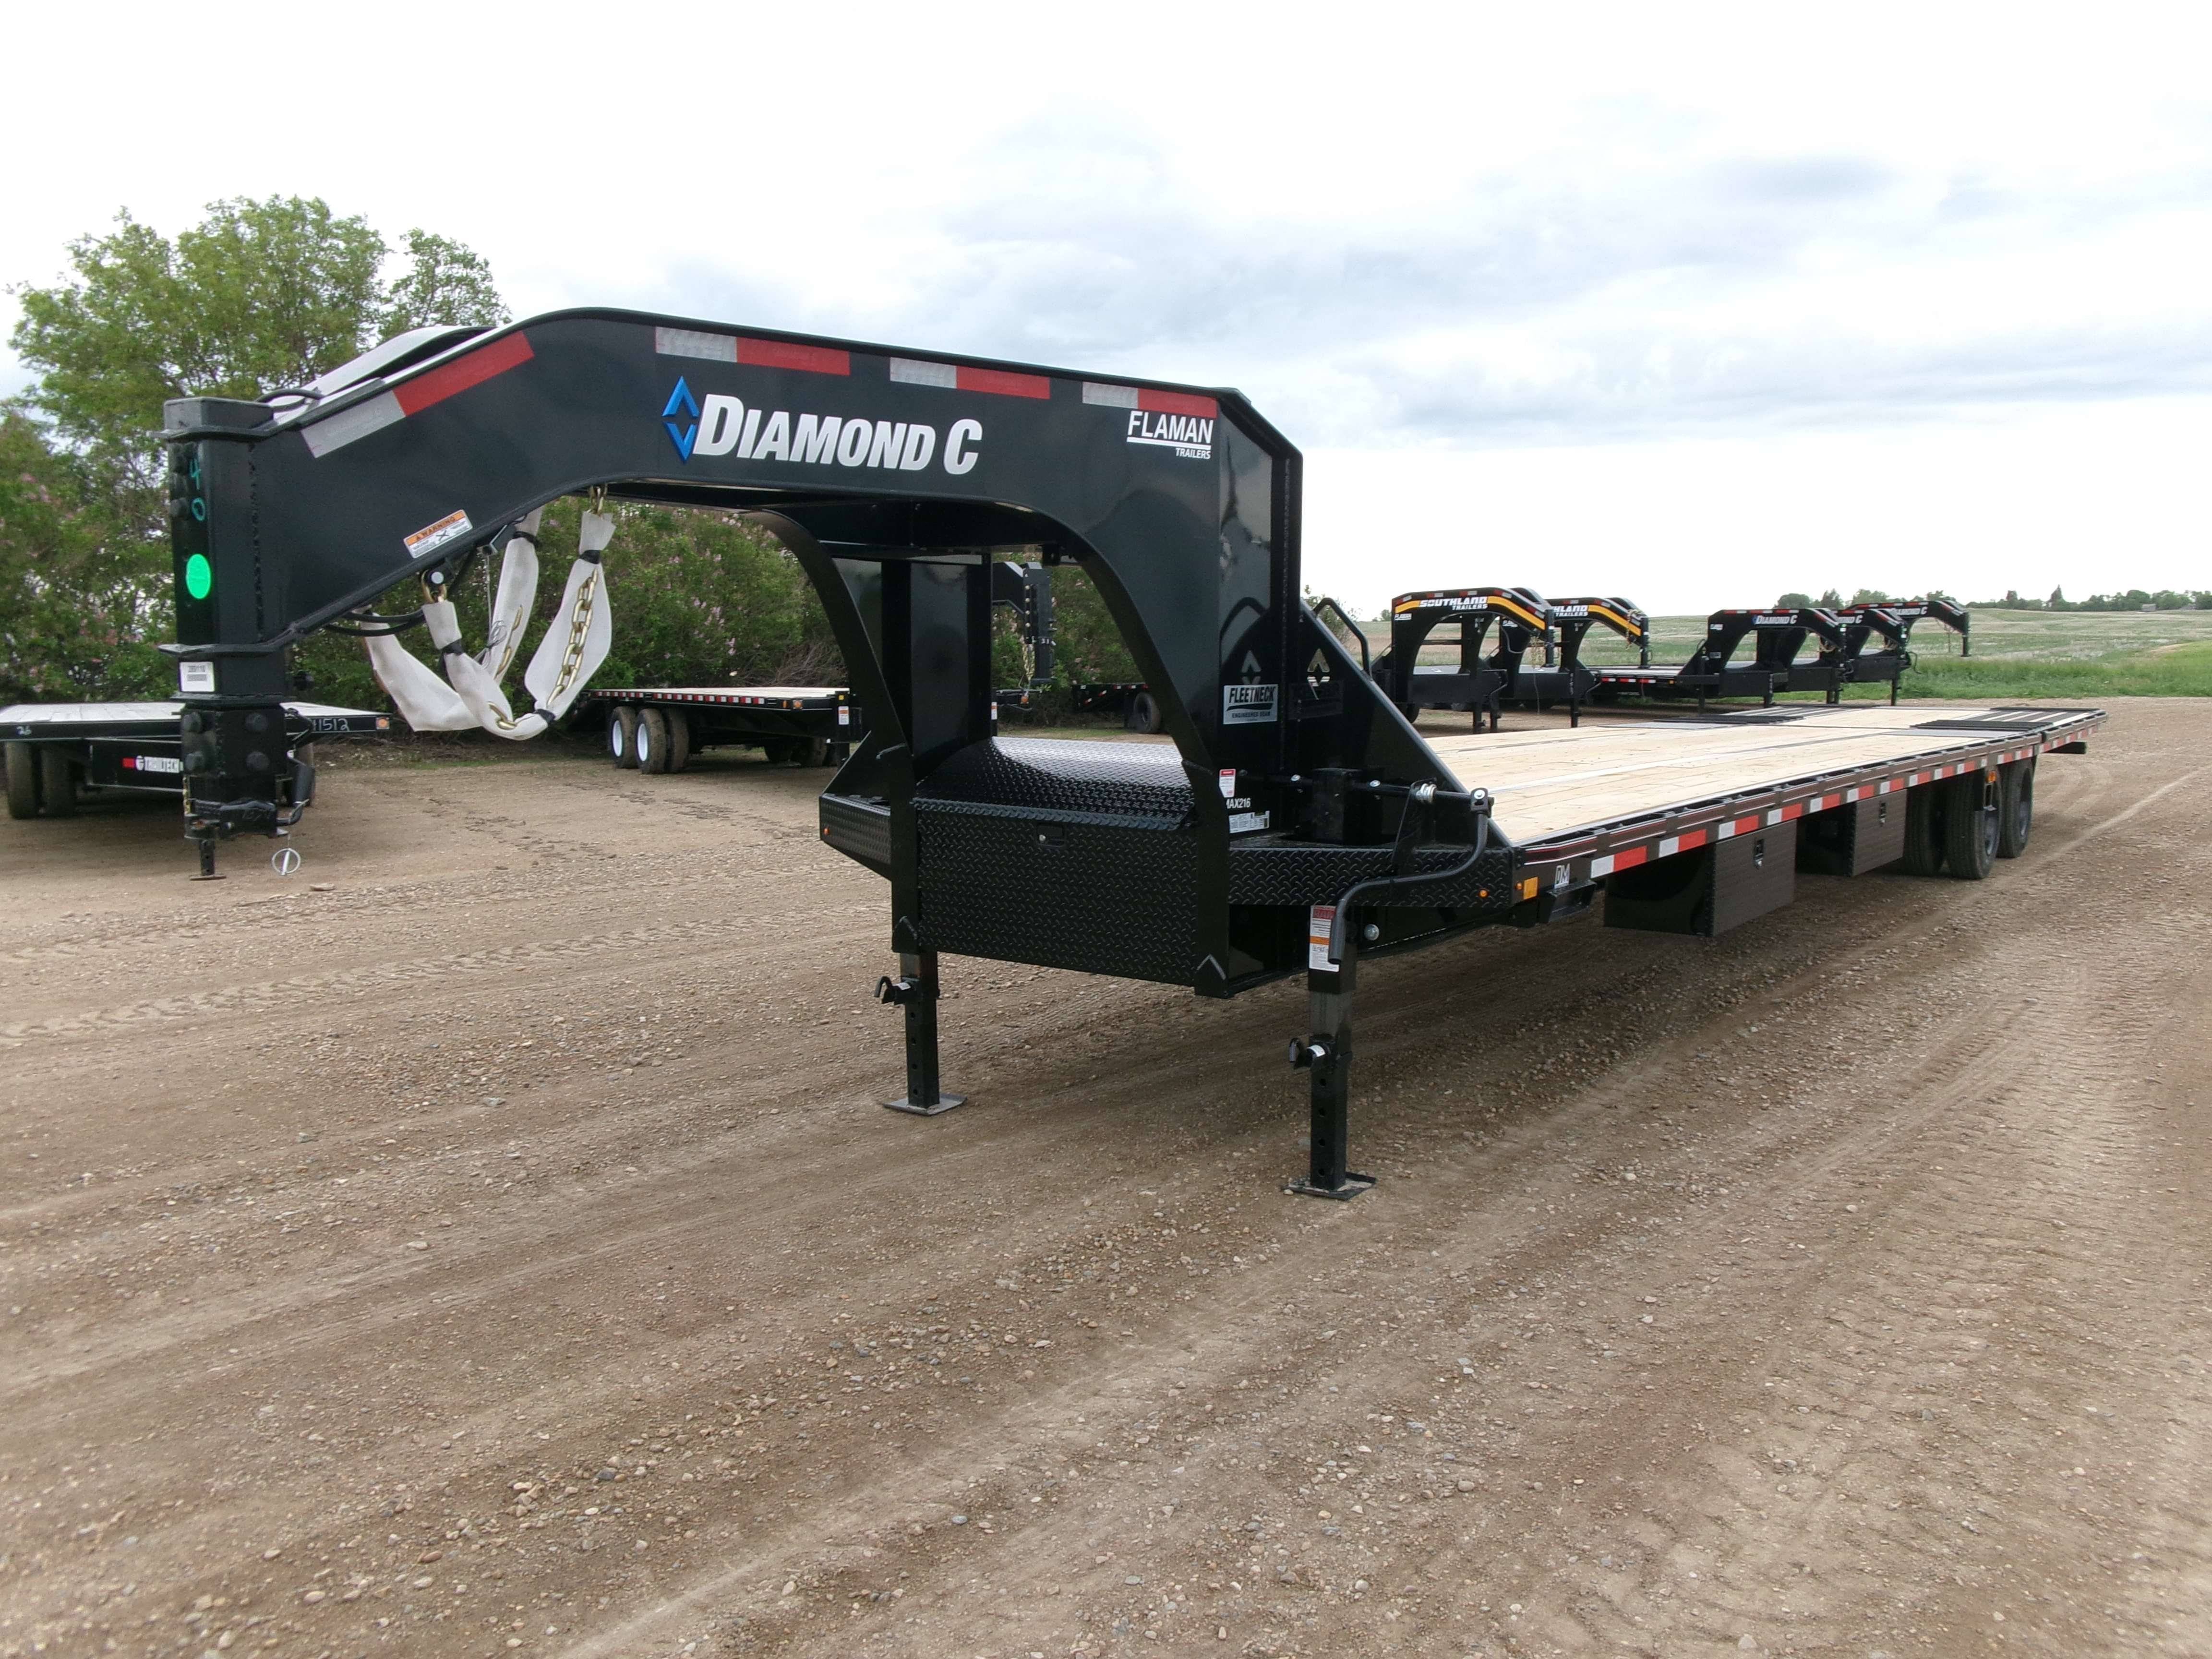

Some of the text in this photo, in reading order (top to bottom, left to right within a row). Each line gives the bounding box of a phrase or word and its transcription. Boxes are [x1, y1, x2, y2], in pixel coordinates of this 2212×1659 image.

[693, 393, 983, 475] DIAMOND C
[1128, 410, 1214, 444] FLAMAN
[1175, 447, 1211, 460] TRAILERS
[422, 516, 456, 536] WARNING
[1419, 596, 1488, 607] SOUTHLAND
[1229, 686, 1275, 703] FLEETNECK
